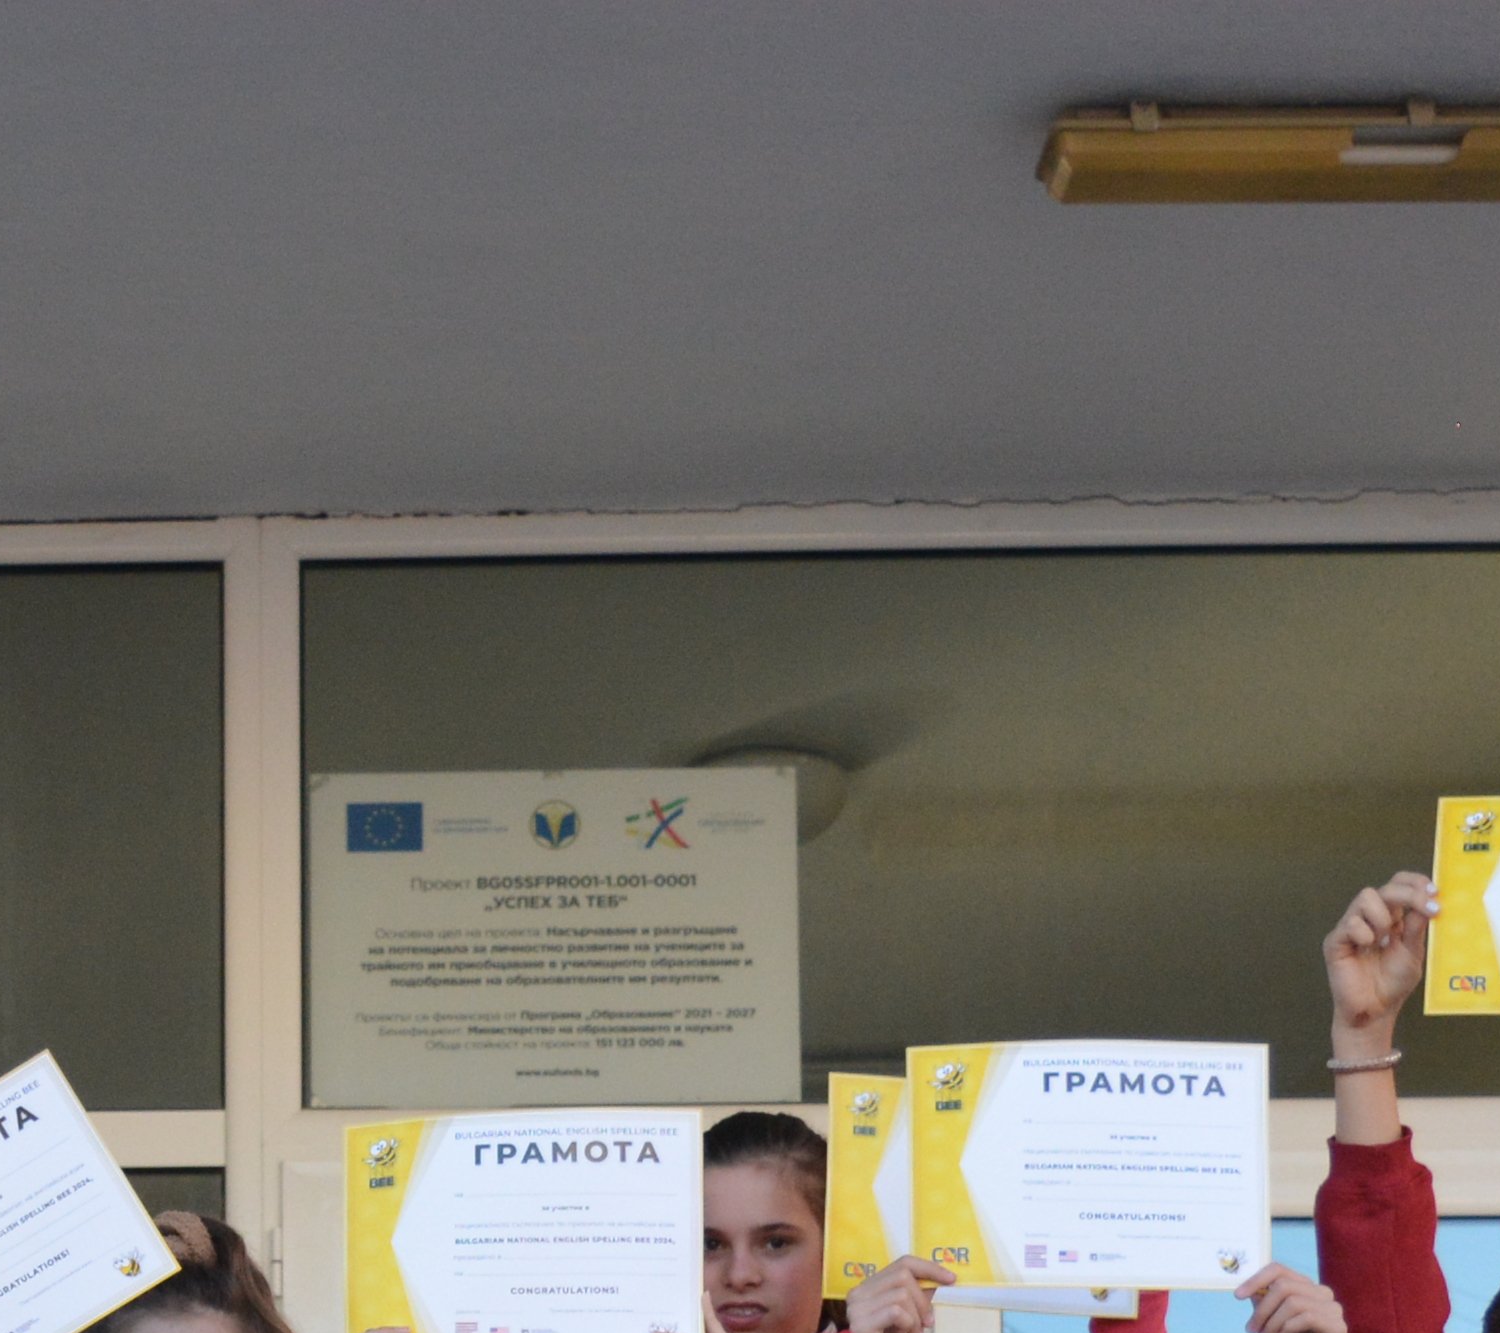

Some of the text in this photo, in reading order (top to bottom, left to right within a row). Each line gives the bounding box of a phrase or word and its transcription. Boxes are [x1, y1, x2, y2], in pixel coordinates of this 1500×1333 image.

[410, 877, 472, 894] Проект
[556, 894, 581, 909] ЗА
[367, 945, 385, 955] на
[471, 945, 487, 954] за
[565, 944, 631, 956] развитие
[632, 943, 651, 953] на
[728, 943, 745, 952] за
[648, 956, 741, 971] образование
[484, 976, 503, 986] на
[557, 1024, 574, 1034] на
[1042, 1072, 1226, 1097] ГРАМОТА
[474, 1140, 660, 1165] ГРАМОТА
[1079, 1212, 1185, 1222] CONGRATULATIONS!
[511, 1286, 619, 1295] CONGRATULATIONS!
